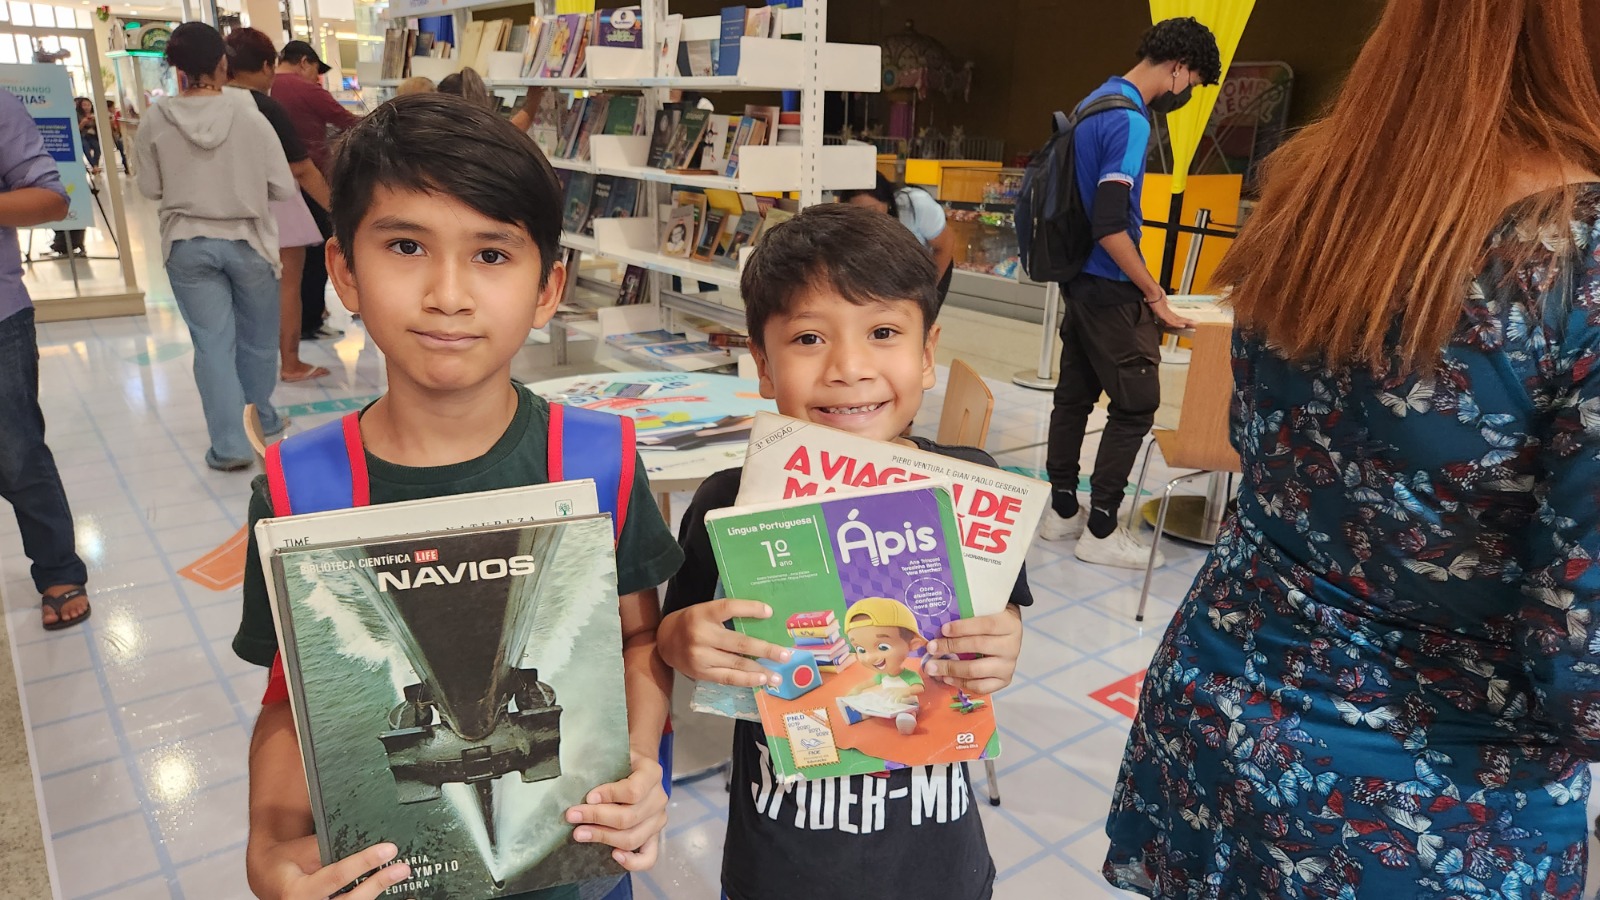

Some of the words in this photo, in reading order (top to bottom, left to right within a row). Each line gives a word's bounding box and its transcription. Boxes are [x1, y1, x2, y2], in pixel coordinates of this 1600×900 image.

[7, 86, 51, 94] TILHANDO
[16, 95, 46, 104] RIAS
[765, 426, 793, 445] EDIÇÃO
[783, 445, 811, 476] A
[968, 488, 1023, 525] DE
[892, 455, 912, 467] PIERO
[914, 460, 944, 474] VENTURA
[946, 468, 951, 476] E
[952, 471, 970, 481] GIAN
[971, 475, 994, 487] PAOLO
[995, 481, 1029, 496] CESERANI
[759, 517, 812, 531] Portuguesa
[283, 536, 311, 548] TIME
[836, 508, 938, 567] Ápis
[300, 559, 355, 573] BIBLIOTECA
[358, 553, 411, 569] CIENTÍFICA
[415, 551, 438, 563] LIFE
[377, 555, 536, 593] NAVIOS
[751, 741, 970, 834] SIDER-MA
[407, 860, 459, 879] LYMPIO
[385, 880, 430, 895] EDITORA
